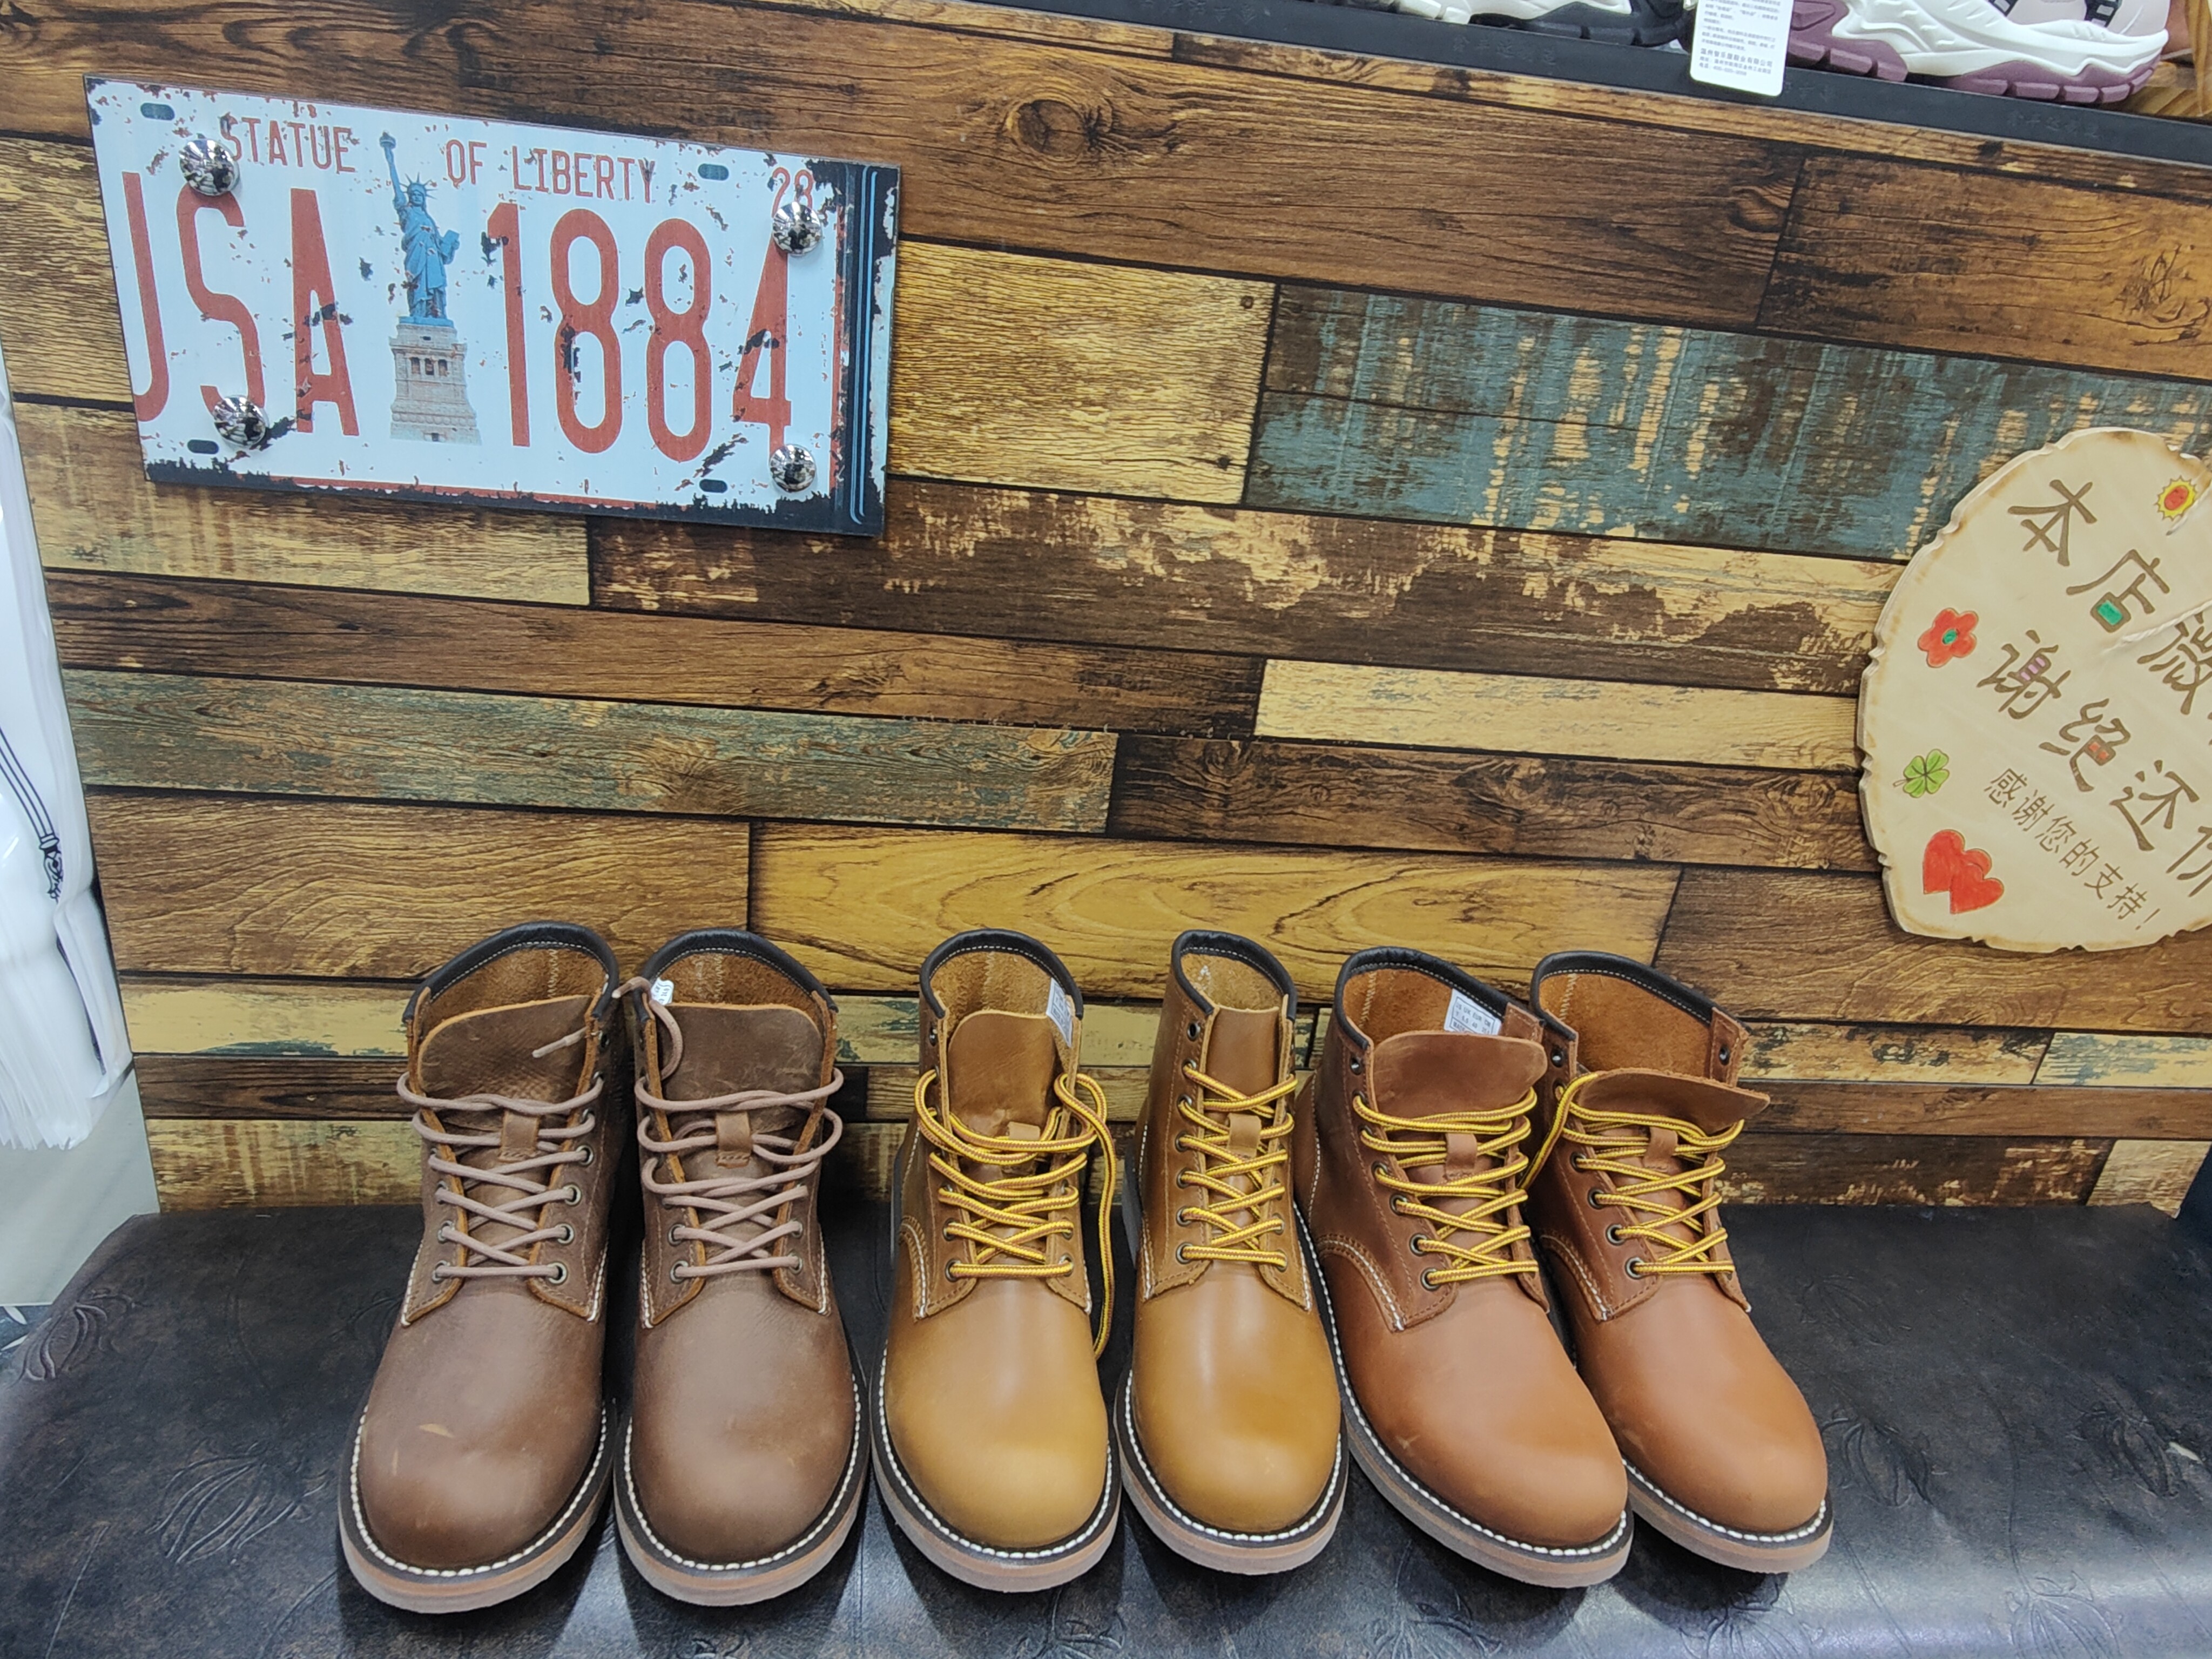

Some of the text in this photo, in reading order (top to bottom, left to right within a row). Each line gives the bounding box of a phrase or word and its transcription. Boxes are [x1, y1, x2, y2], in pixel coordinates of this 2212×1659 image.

[220, 114, 656, 204] STATUE OF LIBERTY
[487, 202, 792, 462] 1884
[2007, 479, 2212, 746] 本店微
